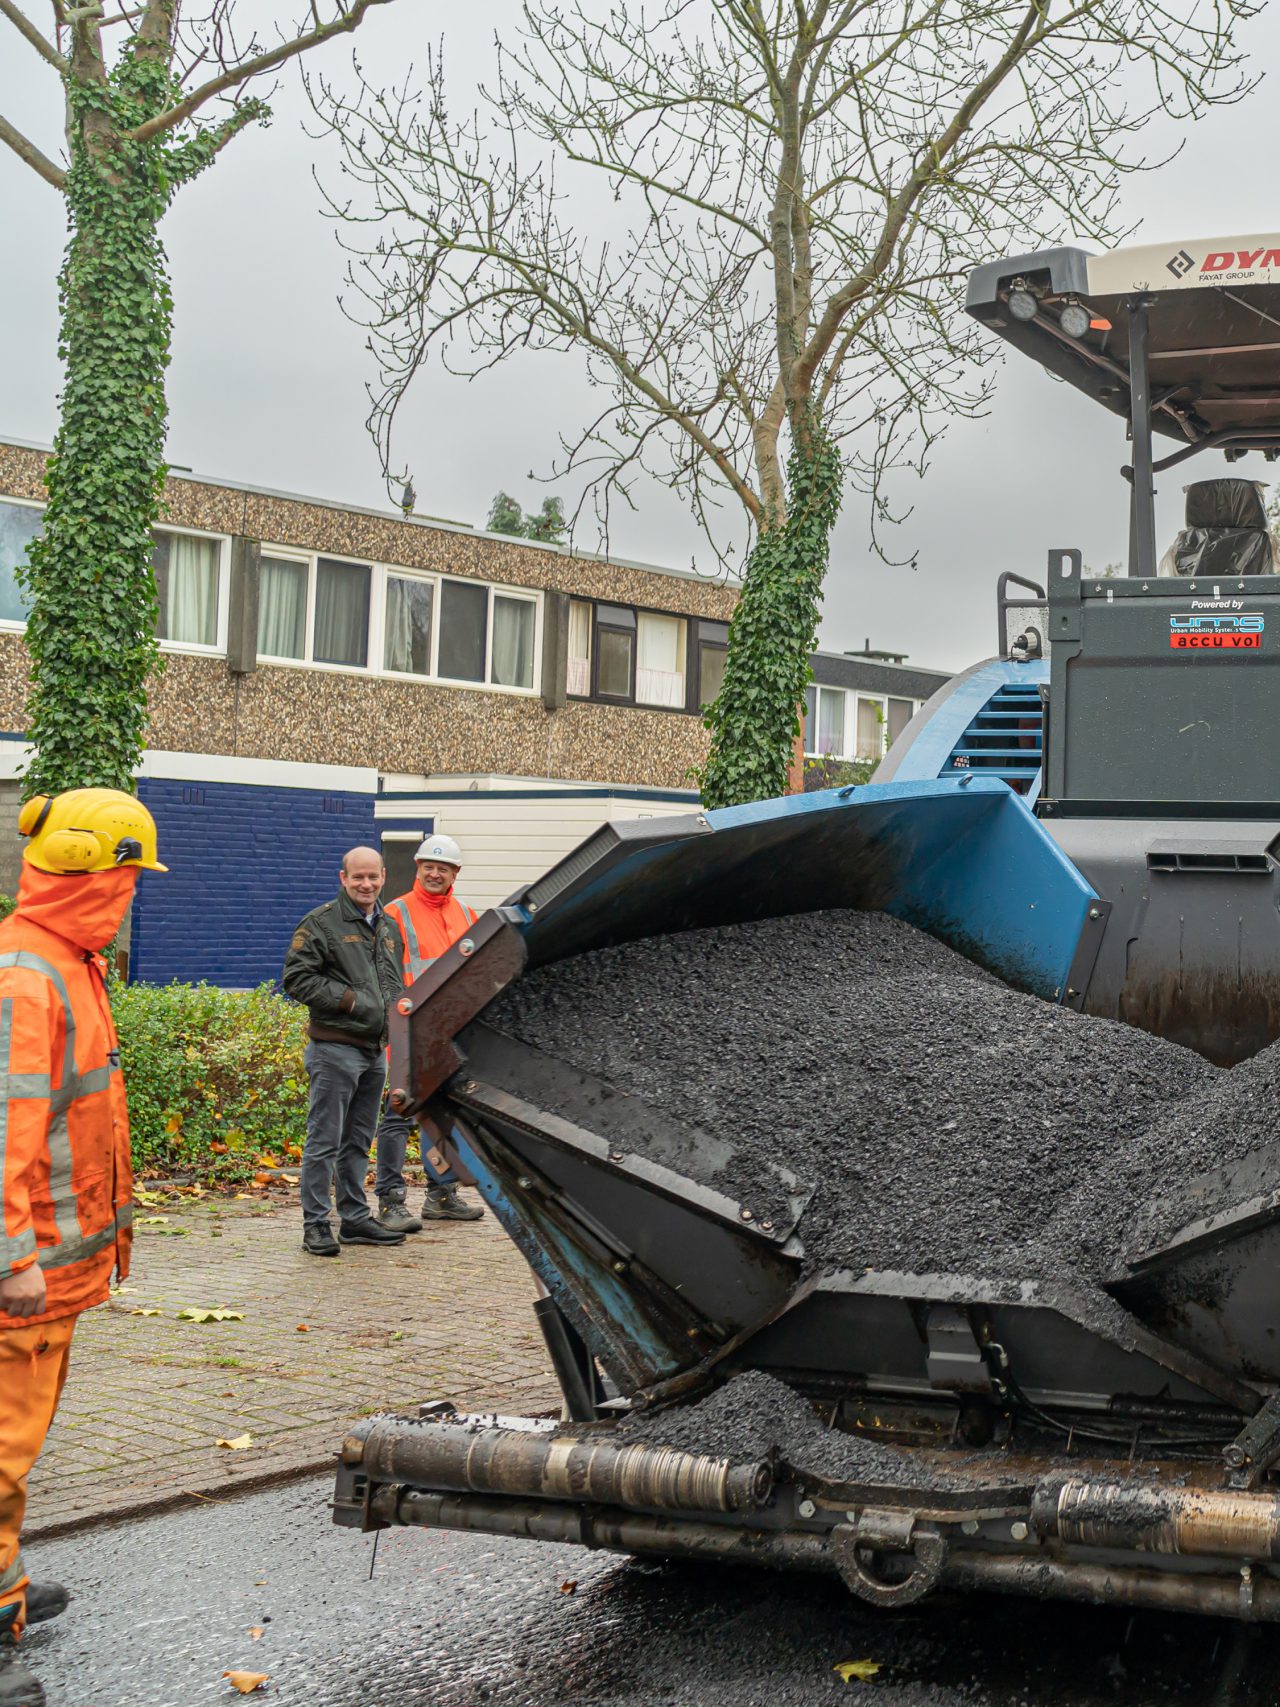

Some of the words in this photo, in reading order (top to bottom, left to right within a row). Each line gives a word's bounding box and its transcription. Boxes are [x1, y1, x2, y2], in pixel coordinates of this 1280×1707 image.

[1199, 272, 1223, 282] FAYAT
[1226, 271, 1255, 280] GROUP
[1191, 600, 1231, 609] Powered
[1232, 600, 1244, 610] by
[1178, 637, 1223, 647] accu
[1232, 634, 1260, 647] vol
